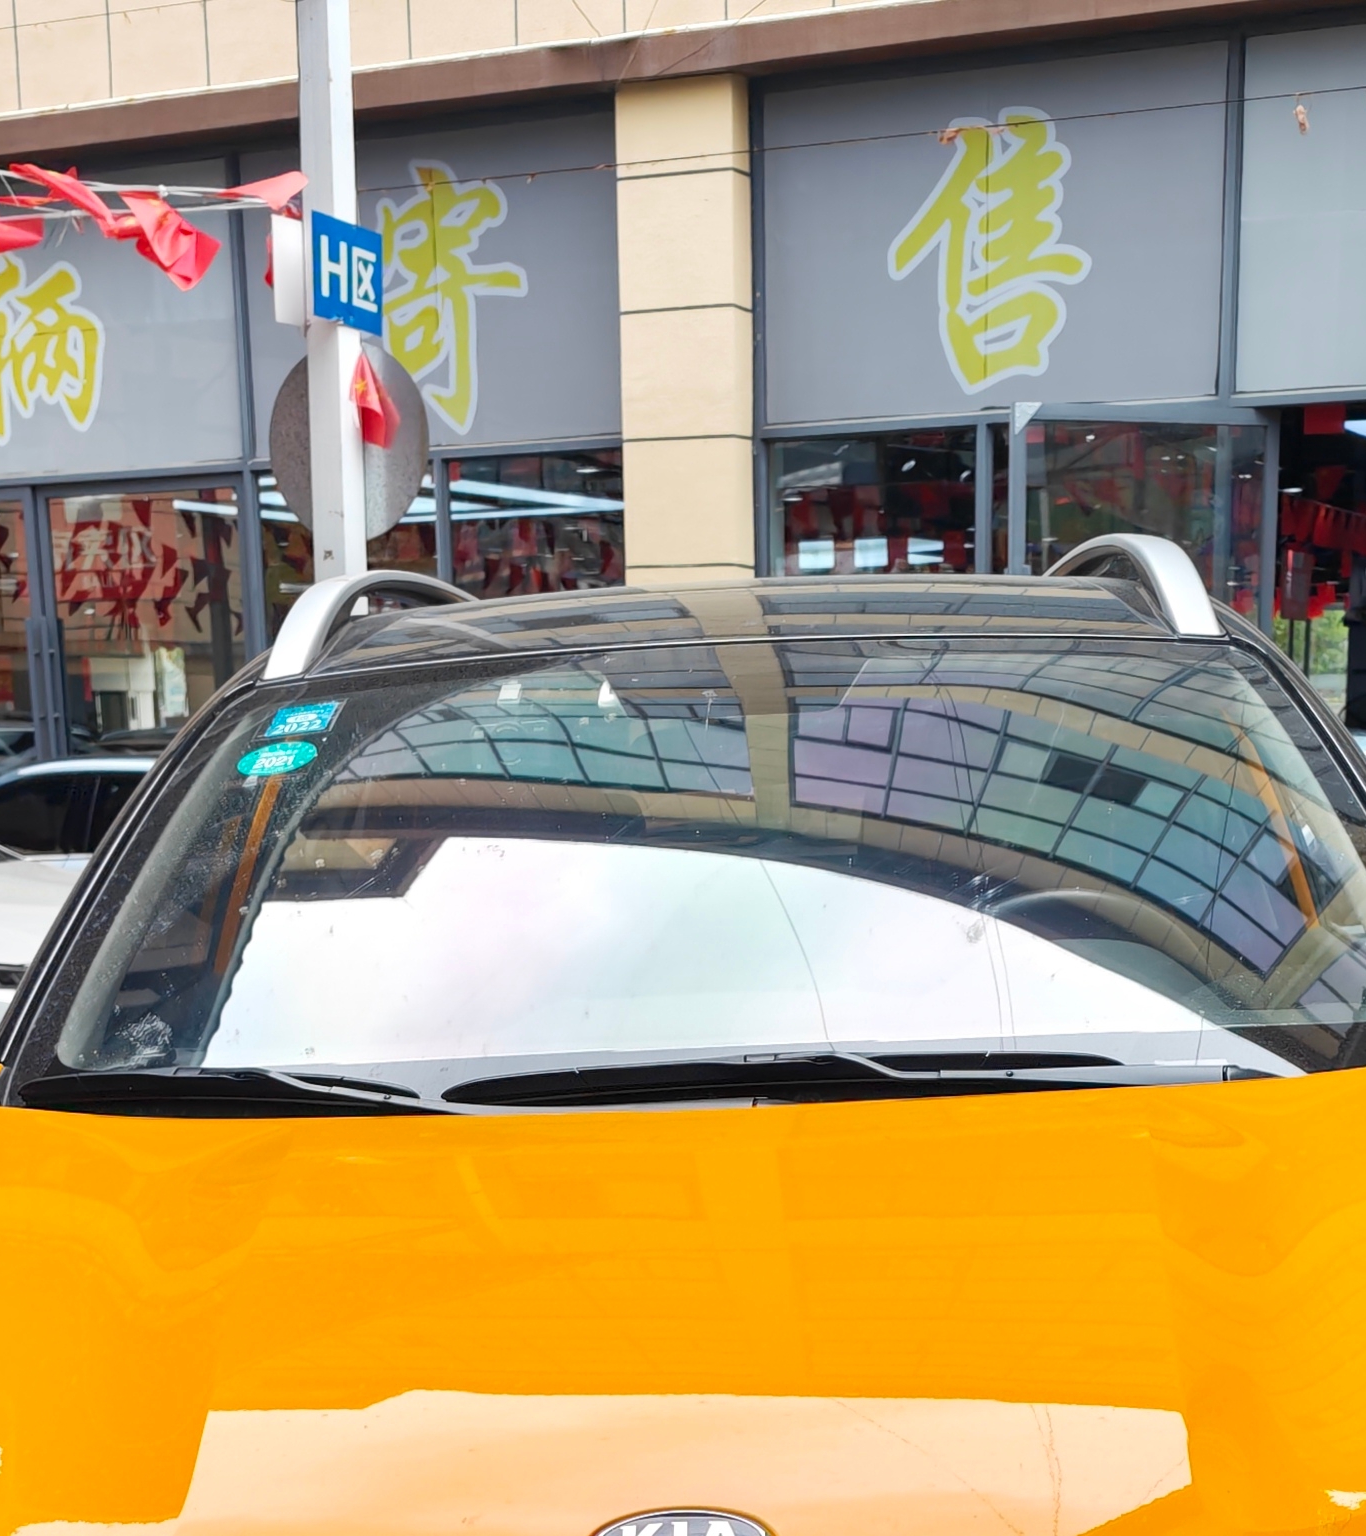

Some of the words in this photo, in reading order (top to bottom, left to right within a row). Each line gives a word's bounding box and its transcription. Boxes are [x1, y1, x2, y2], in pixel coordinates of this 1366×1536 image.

[319, 233, 379, 314] H区
[271, 720, 322, 735] 2022
[255, 756, 295, 769] 2021
